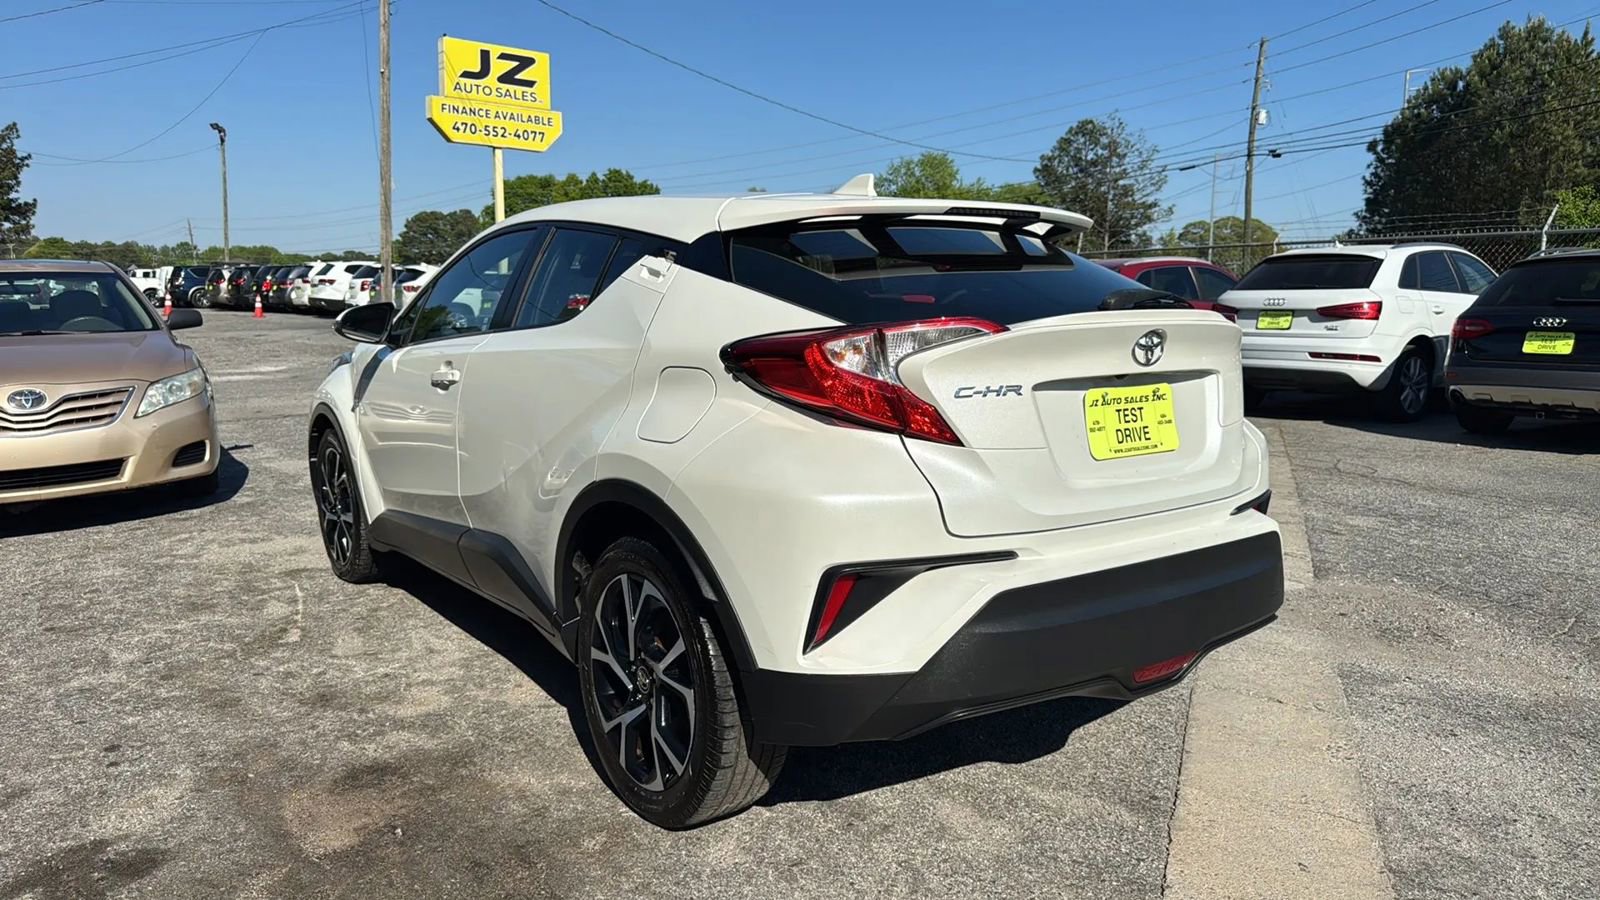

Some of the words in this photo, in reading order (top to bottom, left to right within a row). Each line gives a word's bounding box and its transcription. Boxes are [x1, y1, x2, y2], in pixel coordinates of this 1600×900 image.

[458, 48, 538, 88] JZ
[453, 81, 493, 97] AUTO
[495, 87, 537, 103] SALES
[441, 103, 491, 119] FINANCE
[494, 110, 554, 127] AVAILABLE
[452, 121, 545, 143] 470-552-4077
[953, 384, 1023, 399] C-HR
[1089, 399, 1100, 407] JZ
[1101, 396, 1122, 407] AUTO
[1124, 394, 1150, 405] SALES
[1115, 406, 1144, 425] TEST
[1115, 425, 1152, 445] DRIVE
